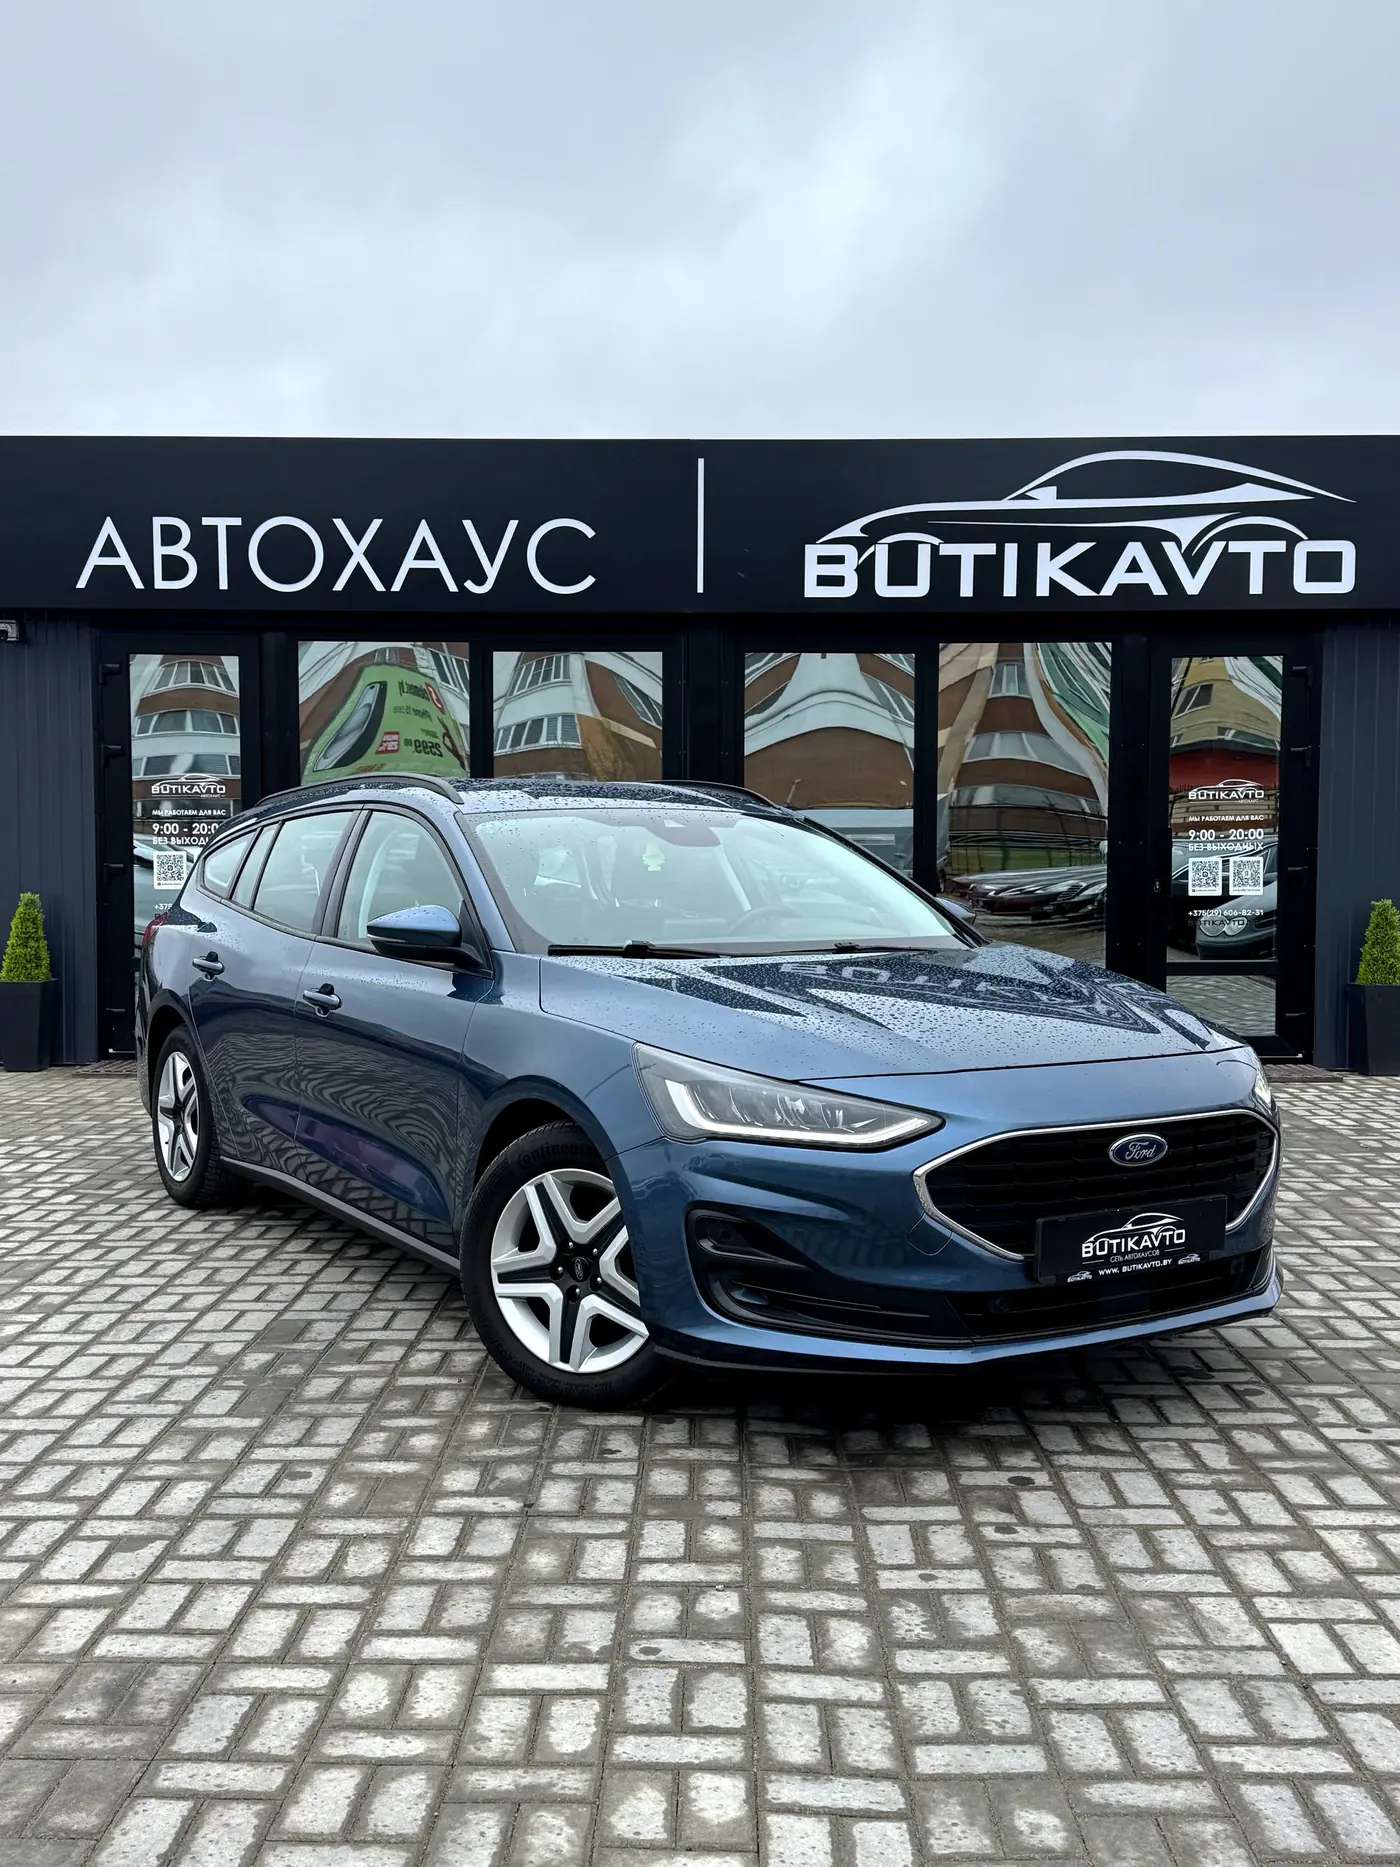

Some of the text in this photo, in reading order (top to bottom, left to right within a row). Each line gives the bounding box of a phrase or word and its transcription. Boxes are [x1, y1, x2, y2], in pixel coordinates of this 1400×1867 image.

[76, 516, 597, 594] АВТОХАУС
[804, 540, 1356, 598] BUTIKAVTO
[151, 784, 226, 794] BUTIKAVTO
[1188, 790, 1264, 800] BUTIKAVTO
[152, 823, 179, 835] 9:00
[192, 823, 219, 835] 20:0
[1188, 829, 1216, 841] 9:00
[1228, 828, 1264, 840] 20:00
[152, 836, 208, 845] БЕЗ ВЫХОД
[1188, 842, 1264, 852] БЕЗ ВЫХОДНЫХ
[1188, 909, 1222, 917] +375(29)
[1124, 1141, 1156, 1160] Ford
[1082, 1229, 1186, 1258] BUTIKAVTO
[1110, 1249, 1160, 1263] СЕТЬ АВТОХАУСОВ
[1122, 1259, 1173, 1273] BUTIKAVTO.BY
